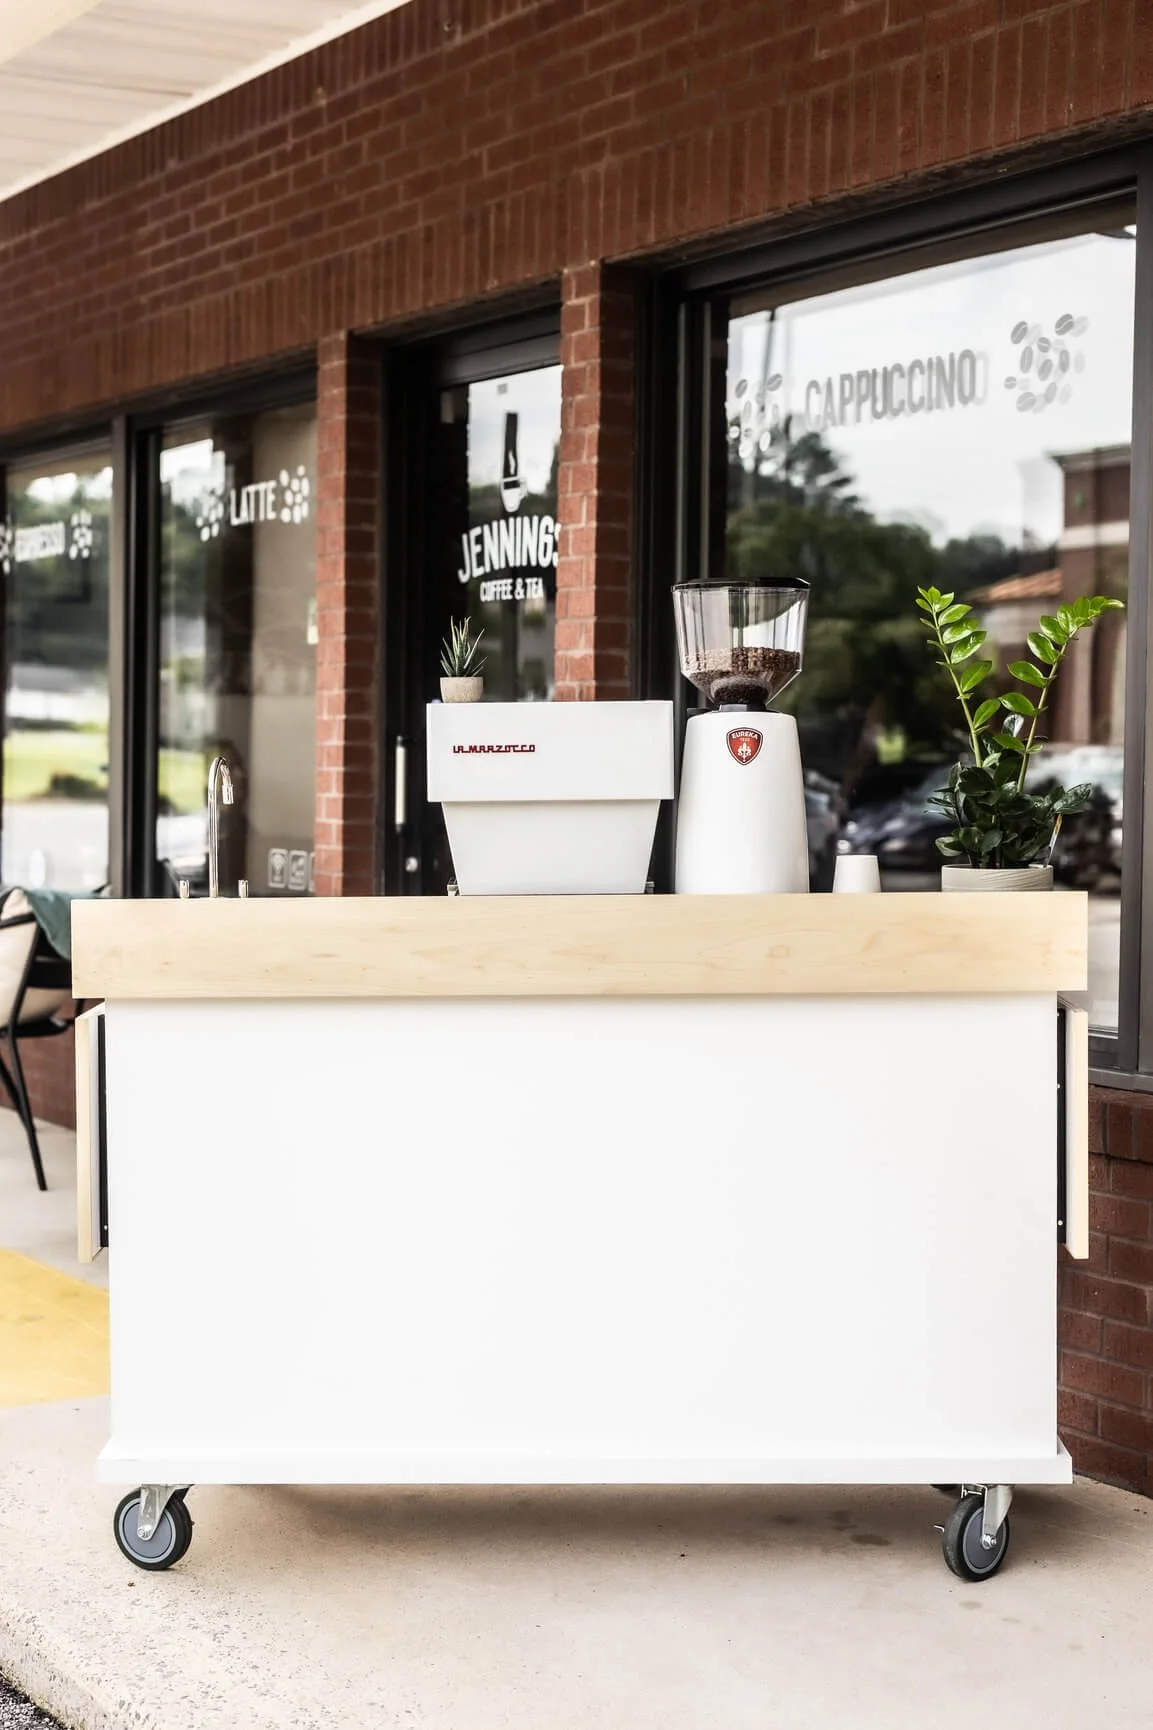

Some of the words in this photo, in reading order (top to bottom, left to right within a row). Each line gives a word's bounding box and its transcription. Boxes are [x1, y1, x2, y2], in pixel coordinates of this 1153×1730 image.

[805, 348, 977, 433] CAPPUCCINO
[230, 480, 277, 526] LATTE
[480, 578, 513, 602] COFFEE
[515, 577, 525, 600] &
[525, 577, 544, 599] TEA
[731, 731, 758, 740] EUREKA
